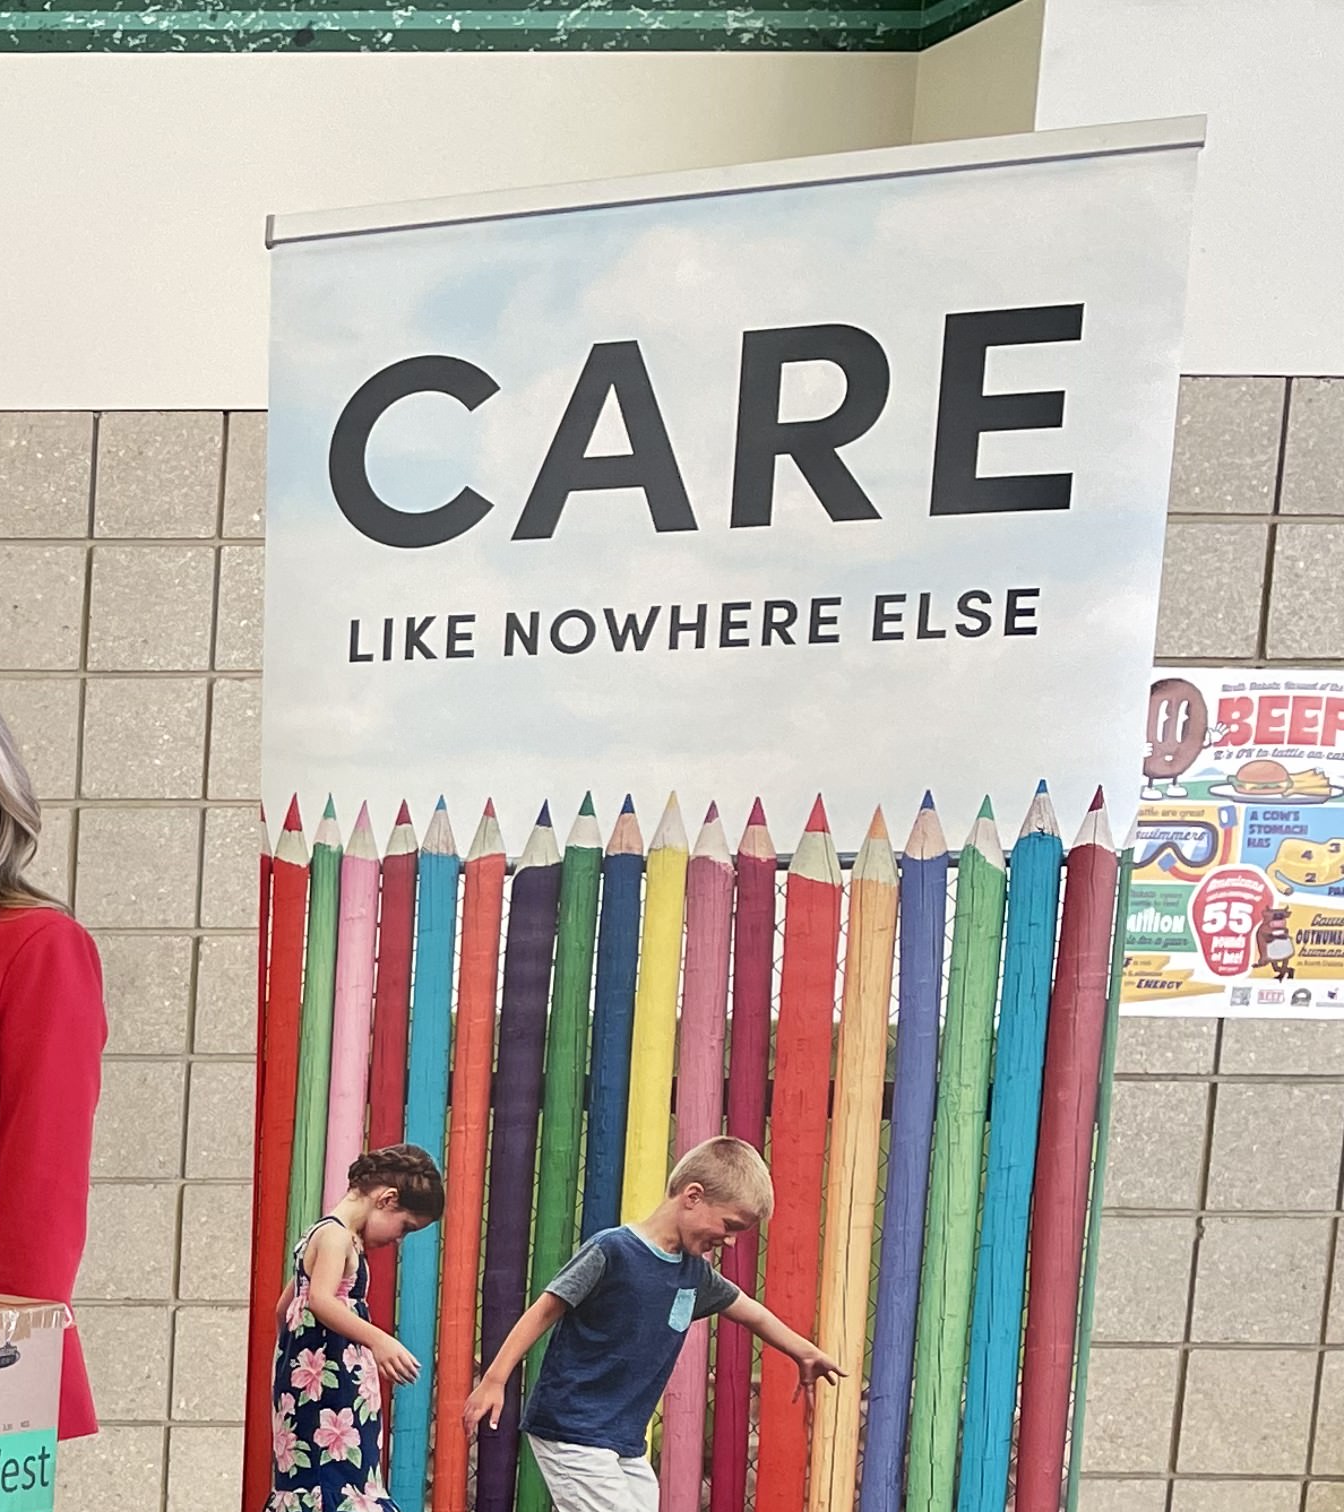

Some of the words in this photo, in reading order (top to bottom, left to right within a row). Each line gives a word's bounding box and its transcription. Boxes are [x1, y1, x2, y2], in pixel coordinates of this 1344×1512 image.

[328, 303, 1086, 549] CARE
[347, 614, 476, 663] LIKE
[503, 597, 842, 658] NOWHERE
[871, 586, 1041, 642] ELSE
[1250, 811, 1258, 821] A
[1201, 901, 1254, 934] 55
[1137, 979, 1183, 990] ENERGY
